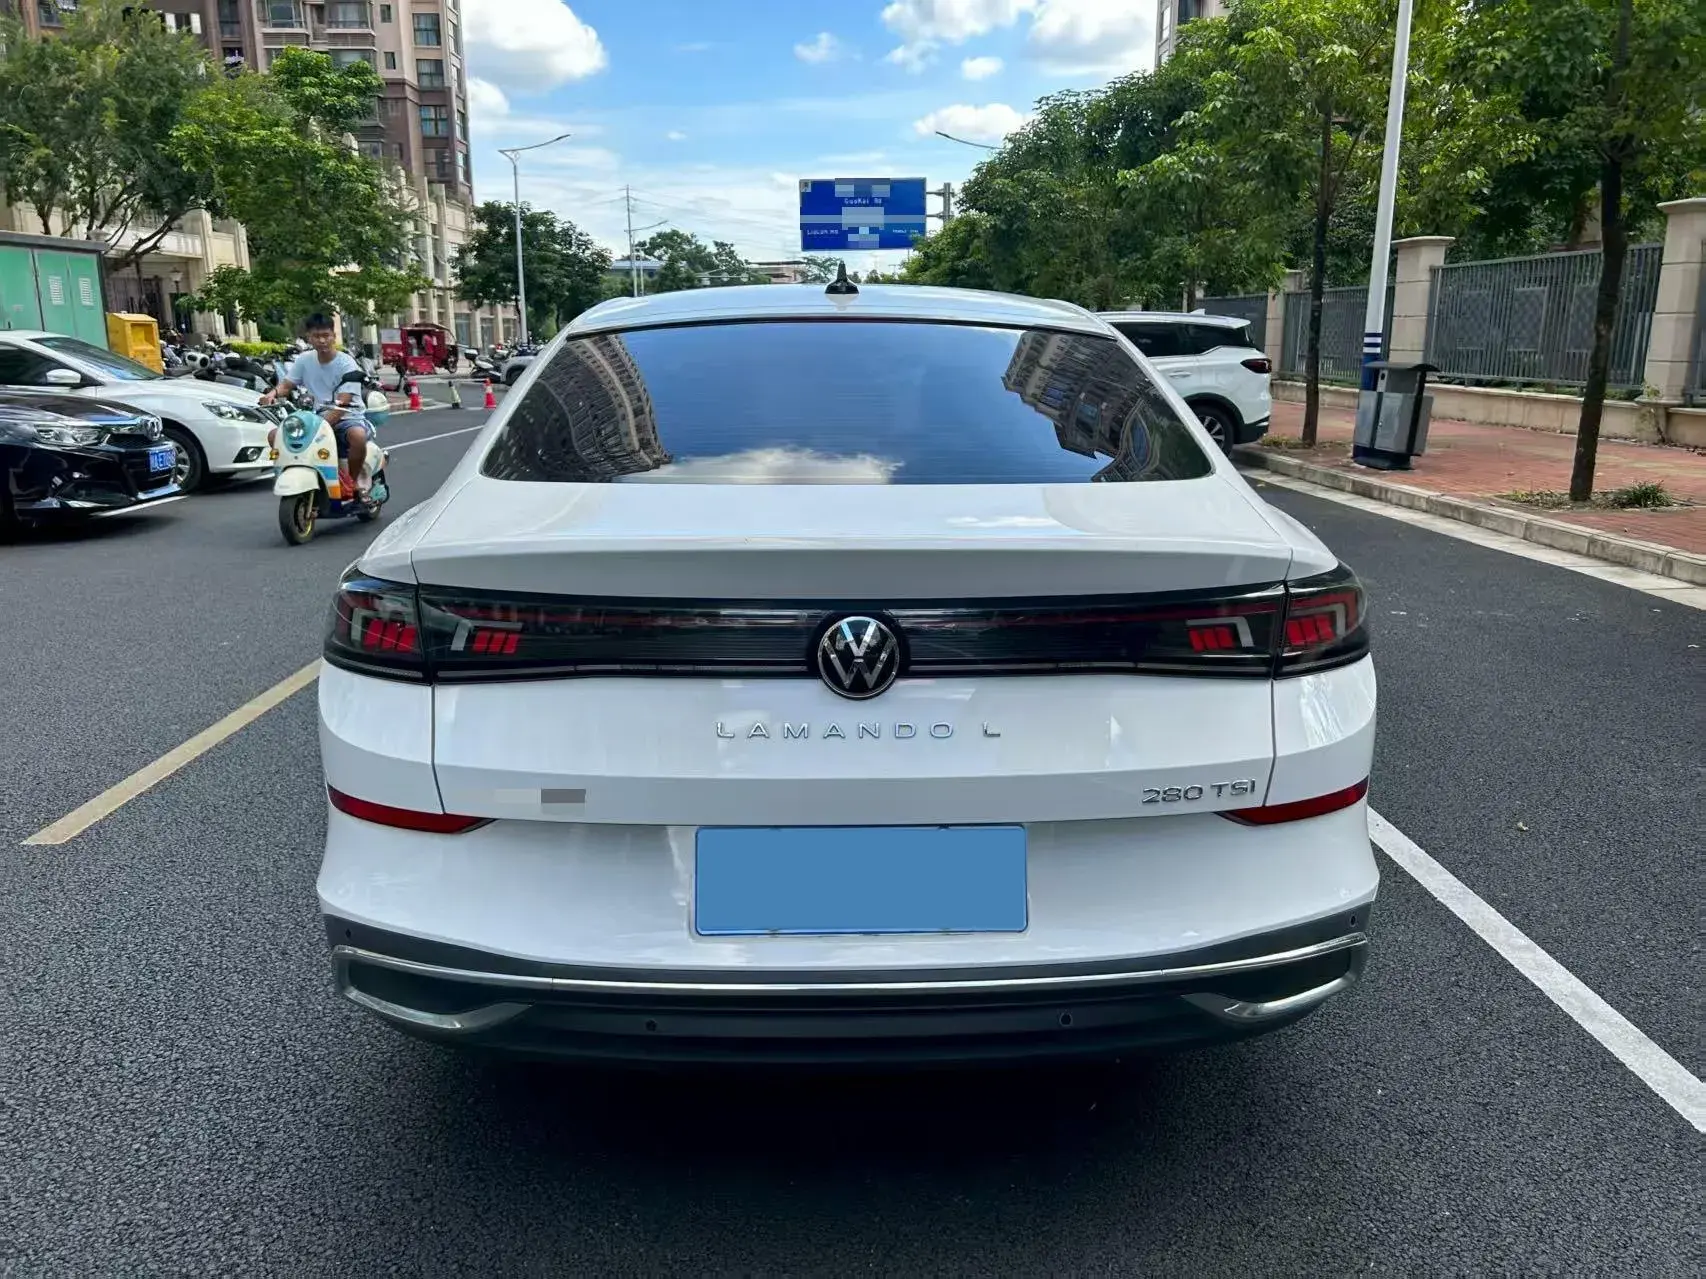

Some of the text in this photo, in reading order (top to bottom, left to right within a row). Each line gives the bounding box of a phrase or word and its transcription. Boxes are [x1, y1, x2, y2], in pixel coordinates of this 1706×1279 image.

[716, 721, 1001, 739] LAMANDO L
[1142, 778, 1256, 803] 280 TSI
